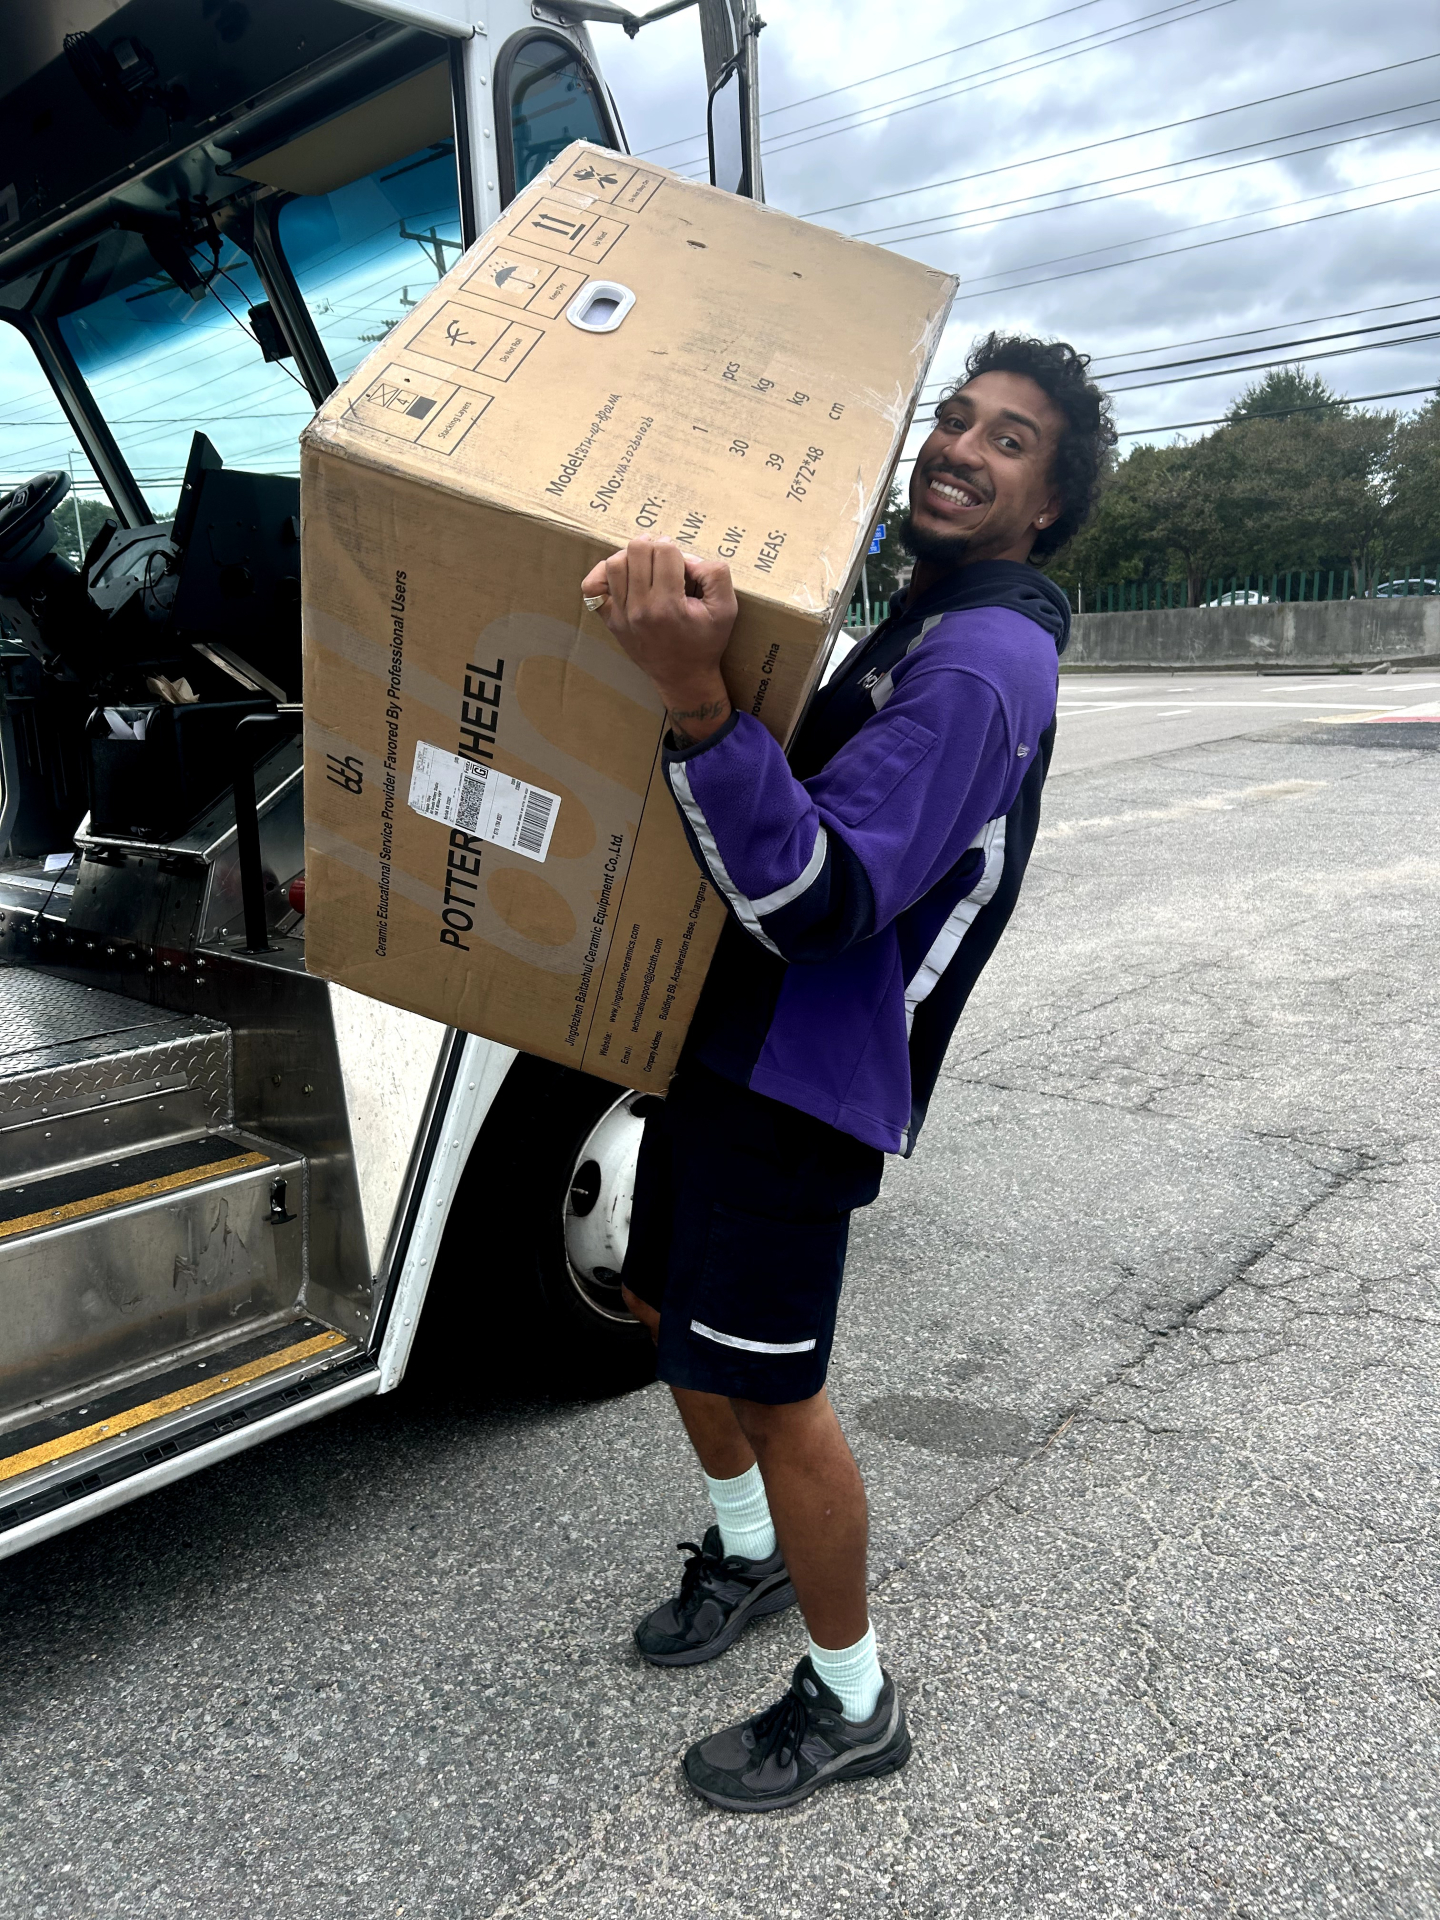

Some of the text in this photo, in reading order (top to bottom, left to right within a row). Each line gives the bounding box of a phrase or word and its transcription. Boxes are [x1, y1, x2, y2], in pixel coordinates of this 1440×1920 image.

[549, 283, 567, 300] Keep Dry
[505, 347, 516, 355] Not
[438, 402, 472, 439] Stacking Layers
[636, 496, 666, 528] QTY:
[722, 362, 740, 380] pcs
[676, 378, 774, 544] N.W: 30 kg
[545, 452, 587, 496] Model:
[718, 391, 810, 558] G.W: 39 kg
[754, 530, 787, 573] MEAS:
[829, 403, 845, 420] cm
[590, 476, 623, 512] S/No:
[762, 644, 780, 674] China
[750, 678, 771, 718] rovince,
[376, 570, 406, 956] Ceramic Educational Service Provider Favored By Professional Users
[440, 828, 483, 951] POTTER
[689, 882, 707, 918] Changnan
[683, 922, 697, 940] Base,
[565, 1004, 584, 1046] Jingdezhen
[575, 963, 593, 1003] Baitaohui
[584, 927, 602, 962] Ceramic
[593, 874, 614, 925] Equipment
[670, 941, 689, 982] Acceleration
[599, 924, 640, 1056] Website: www.jingdezhen-ceramics.com
[659, 994, 675, 1020] Building
[621, 1044, 632, 1064] Email:
[650, 1031, 663, 1051] Address:
[643, 1051, 658, 1072] Company
